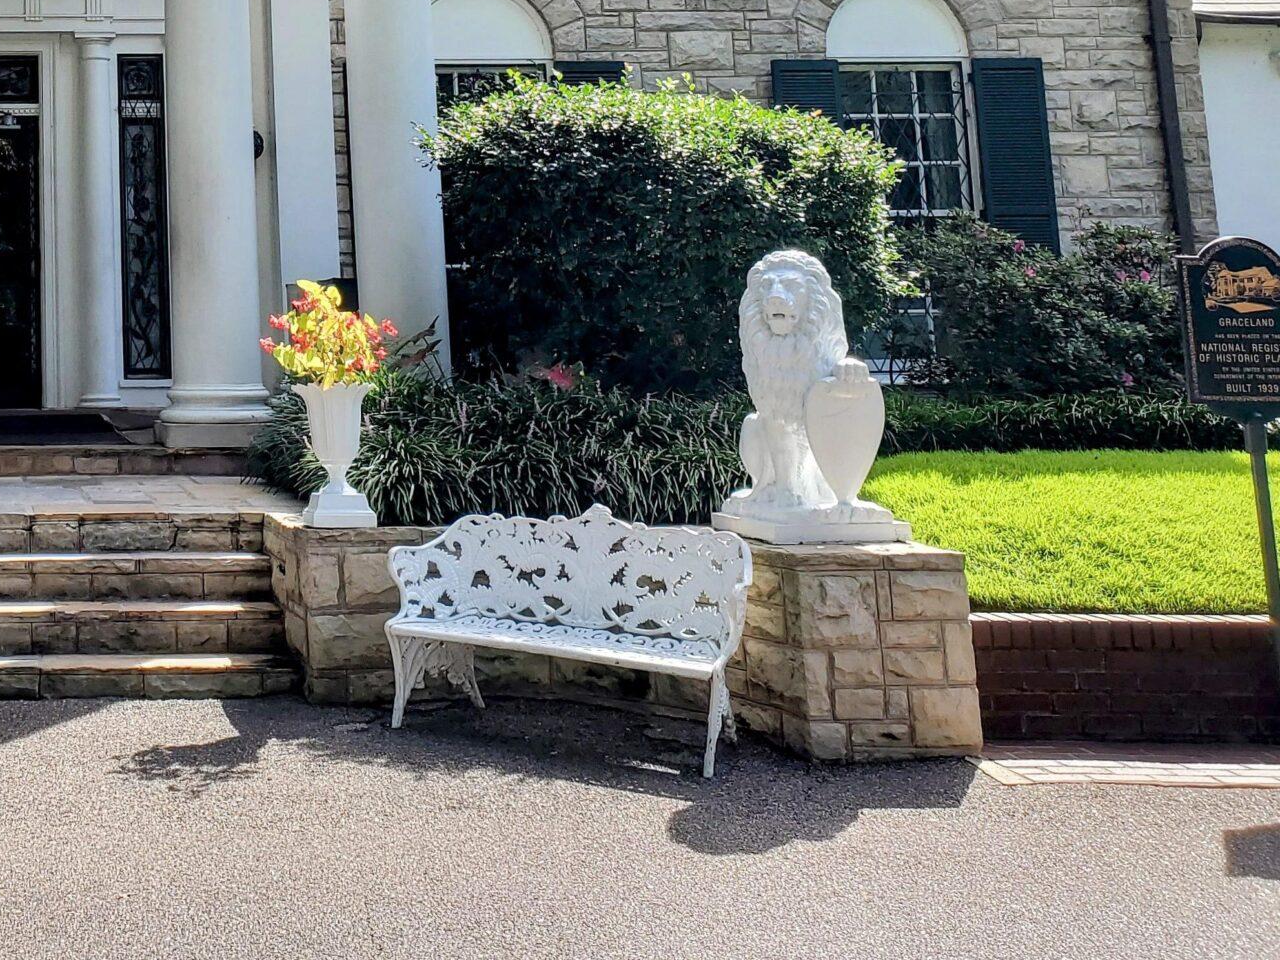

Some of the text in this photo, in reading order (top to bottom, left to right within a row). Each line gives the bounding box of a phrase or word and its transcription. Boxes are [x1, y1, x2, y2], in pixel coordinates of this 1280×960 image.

[1218, 317, 1275, 327] GRACELAND
[1201, 343, 1280, 353] NATIONAL REGIS
[1199, 353, 1211, 363] OF
[1216, 353, 1260, 363] HISTORIC
[1226, 383, 1279, 393] BUILT 1939
